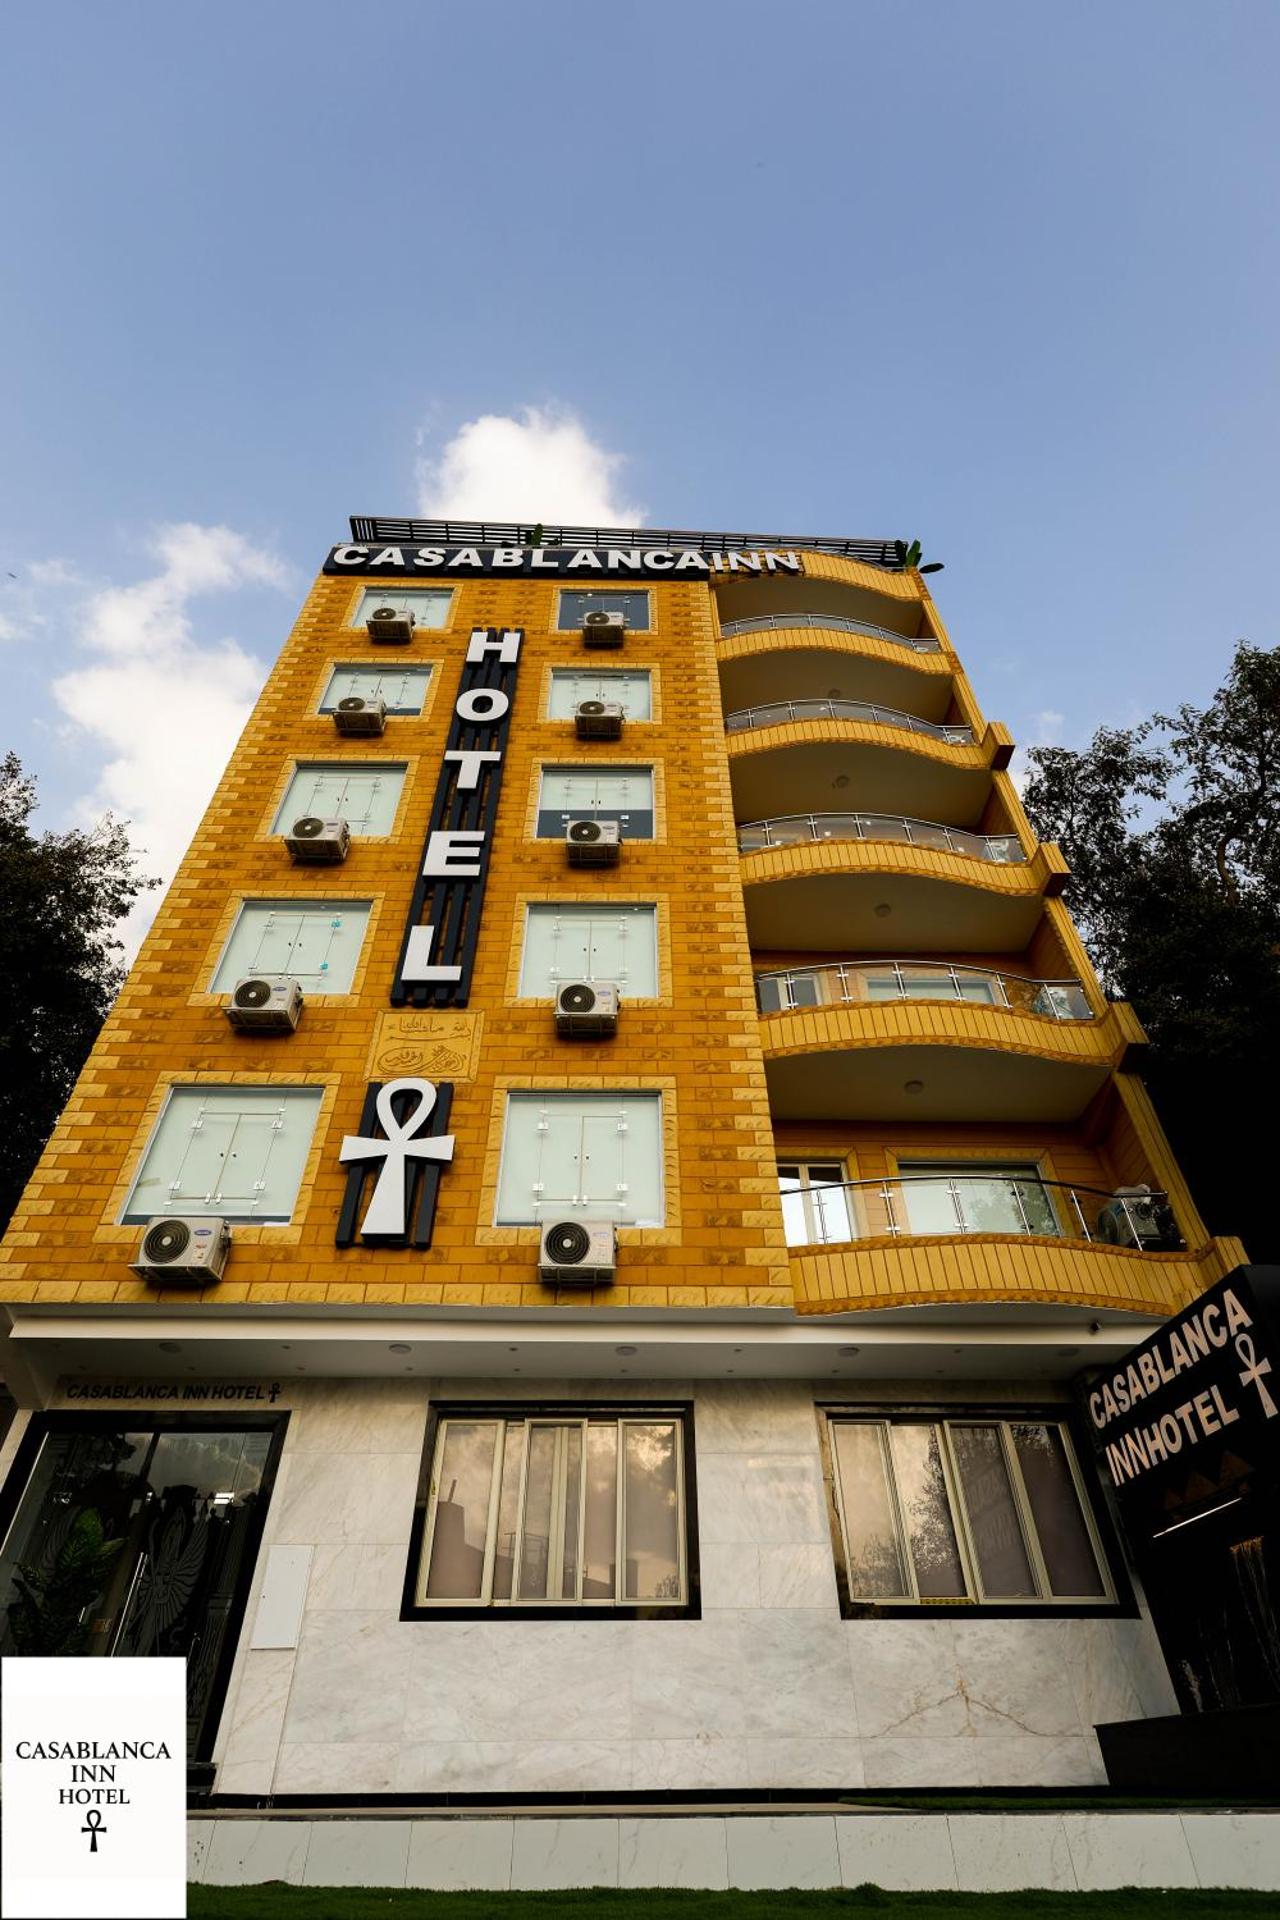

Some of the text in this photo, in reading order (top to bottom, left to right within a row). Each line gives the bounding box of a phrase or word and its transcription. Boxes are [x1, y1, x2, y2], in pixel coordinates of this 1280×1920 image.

[400, 631, 521, 982] HOTEL
[66, 1384, 179, 1400] CASABLANCA
[1089, 1288, 1253, 1429] CASABLANCA
